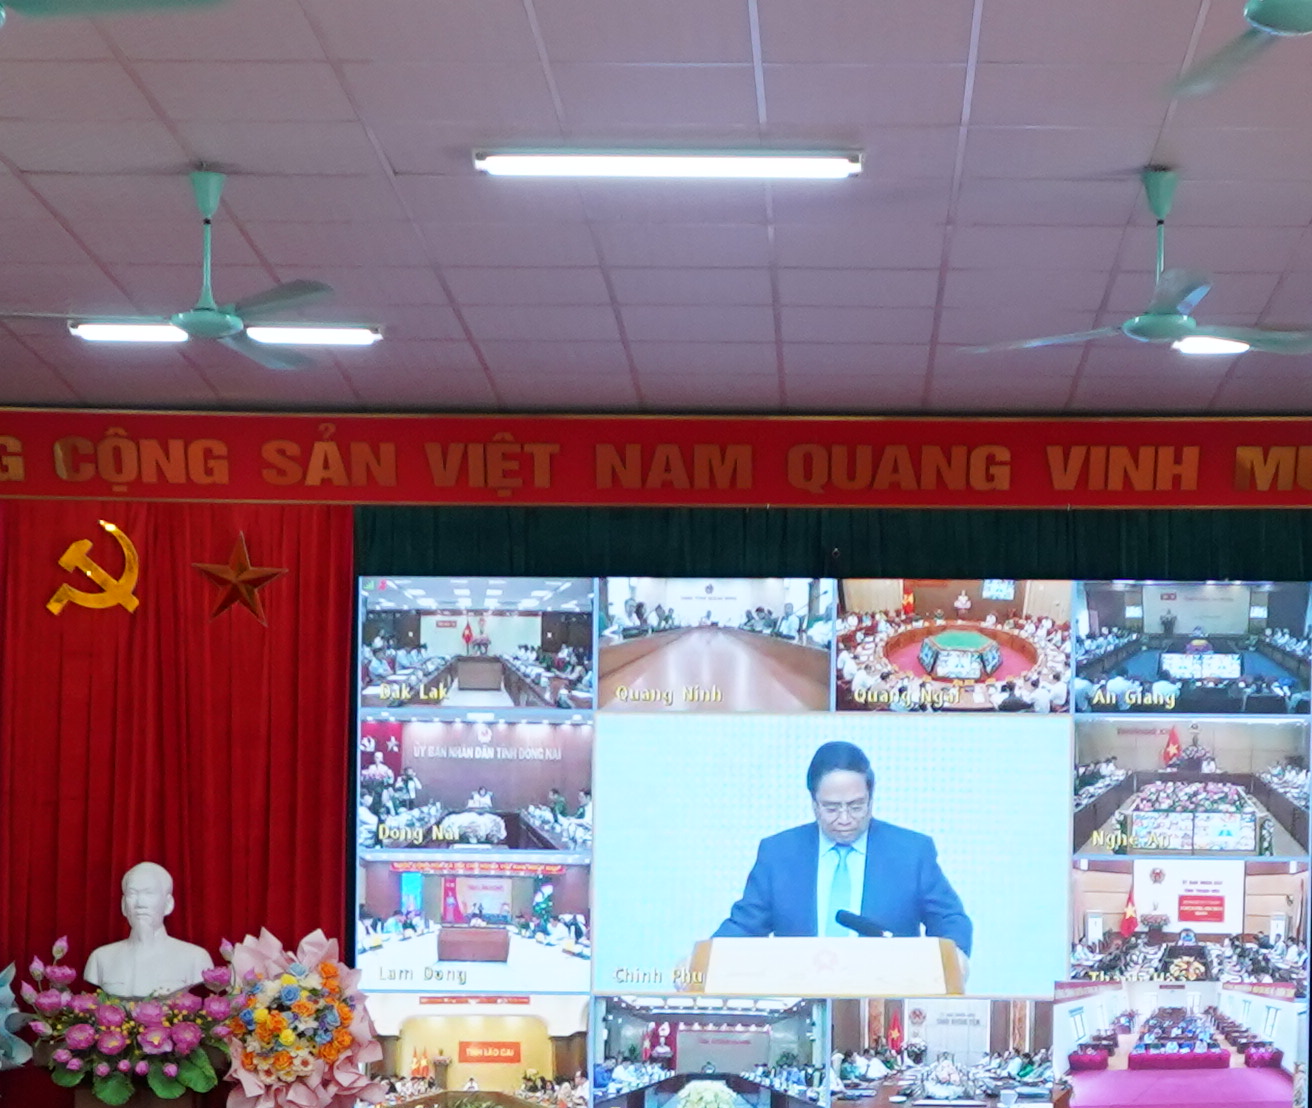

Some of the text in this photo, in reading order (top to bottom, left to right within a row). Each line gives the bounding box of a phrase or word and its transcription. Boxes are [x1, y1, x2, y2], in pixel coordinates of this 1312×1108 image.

[53, 427, 229, 492] CỘNG
[261, 422, 396, 487] SẢN
[424, 431, 560, 498] VIỆT
[595, 443, 753, 490] NAM
[788, 444, 1011, 494] QUANG
[1046, 445, 1200, 491] VINH
[419, 682, 448, 700] Lak
[615, 685, 724, 706] Quang Ninh
[853, 687, 960, 708] Quang Ngai
[1092, 689, 1177, 710] An Giang
[378, 824, 461, 844] Dong Nai
[1091, 831, 1139, 850] Nghe
[379, 966, 467, 985] Lam Dong
[614, 967, 705, 984] Chinh Phu
